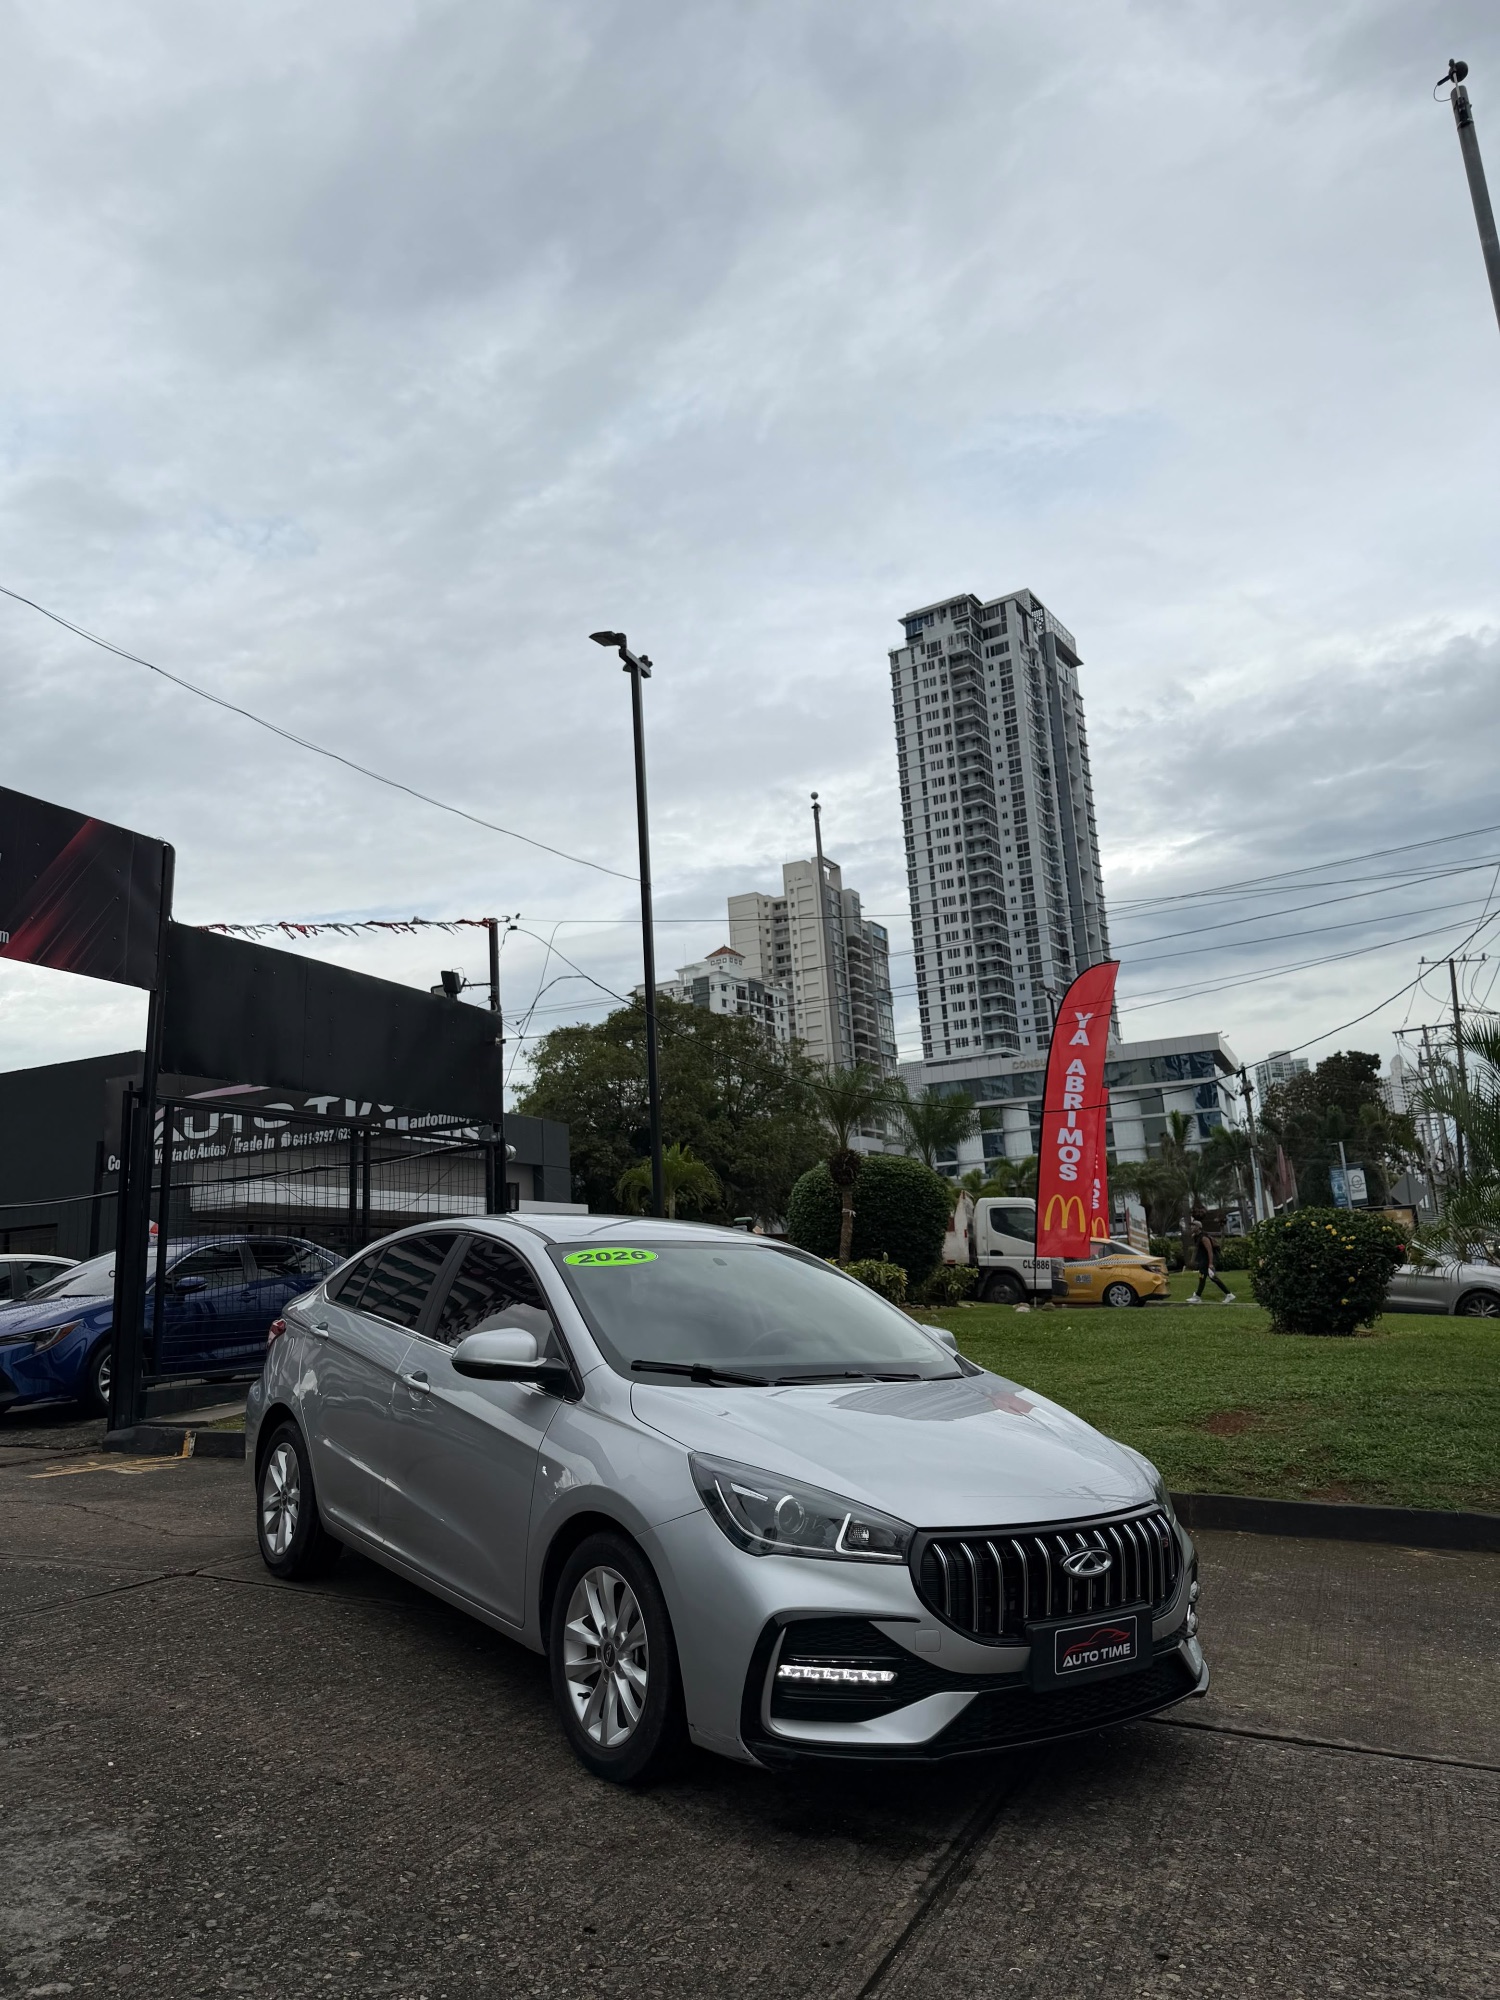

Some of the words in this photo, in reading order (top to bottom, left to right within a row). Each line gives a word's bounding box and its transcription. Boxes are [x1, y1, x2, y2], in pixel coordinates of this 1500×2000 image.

[1069, 1012, 1094, 1046] YA
[1057, 1059, 1087, 1182] ABRIMOS
[577, 1250, 648, 1264] 2026
[1062, 1650, 1099, 1668] AUTO
[1101, 1643, 1131, 1660] TIME
